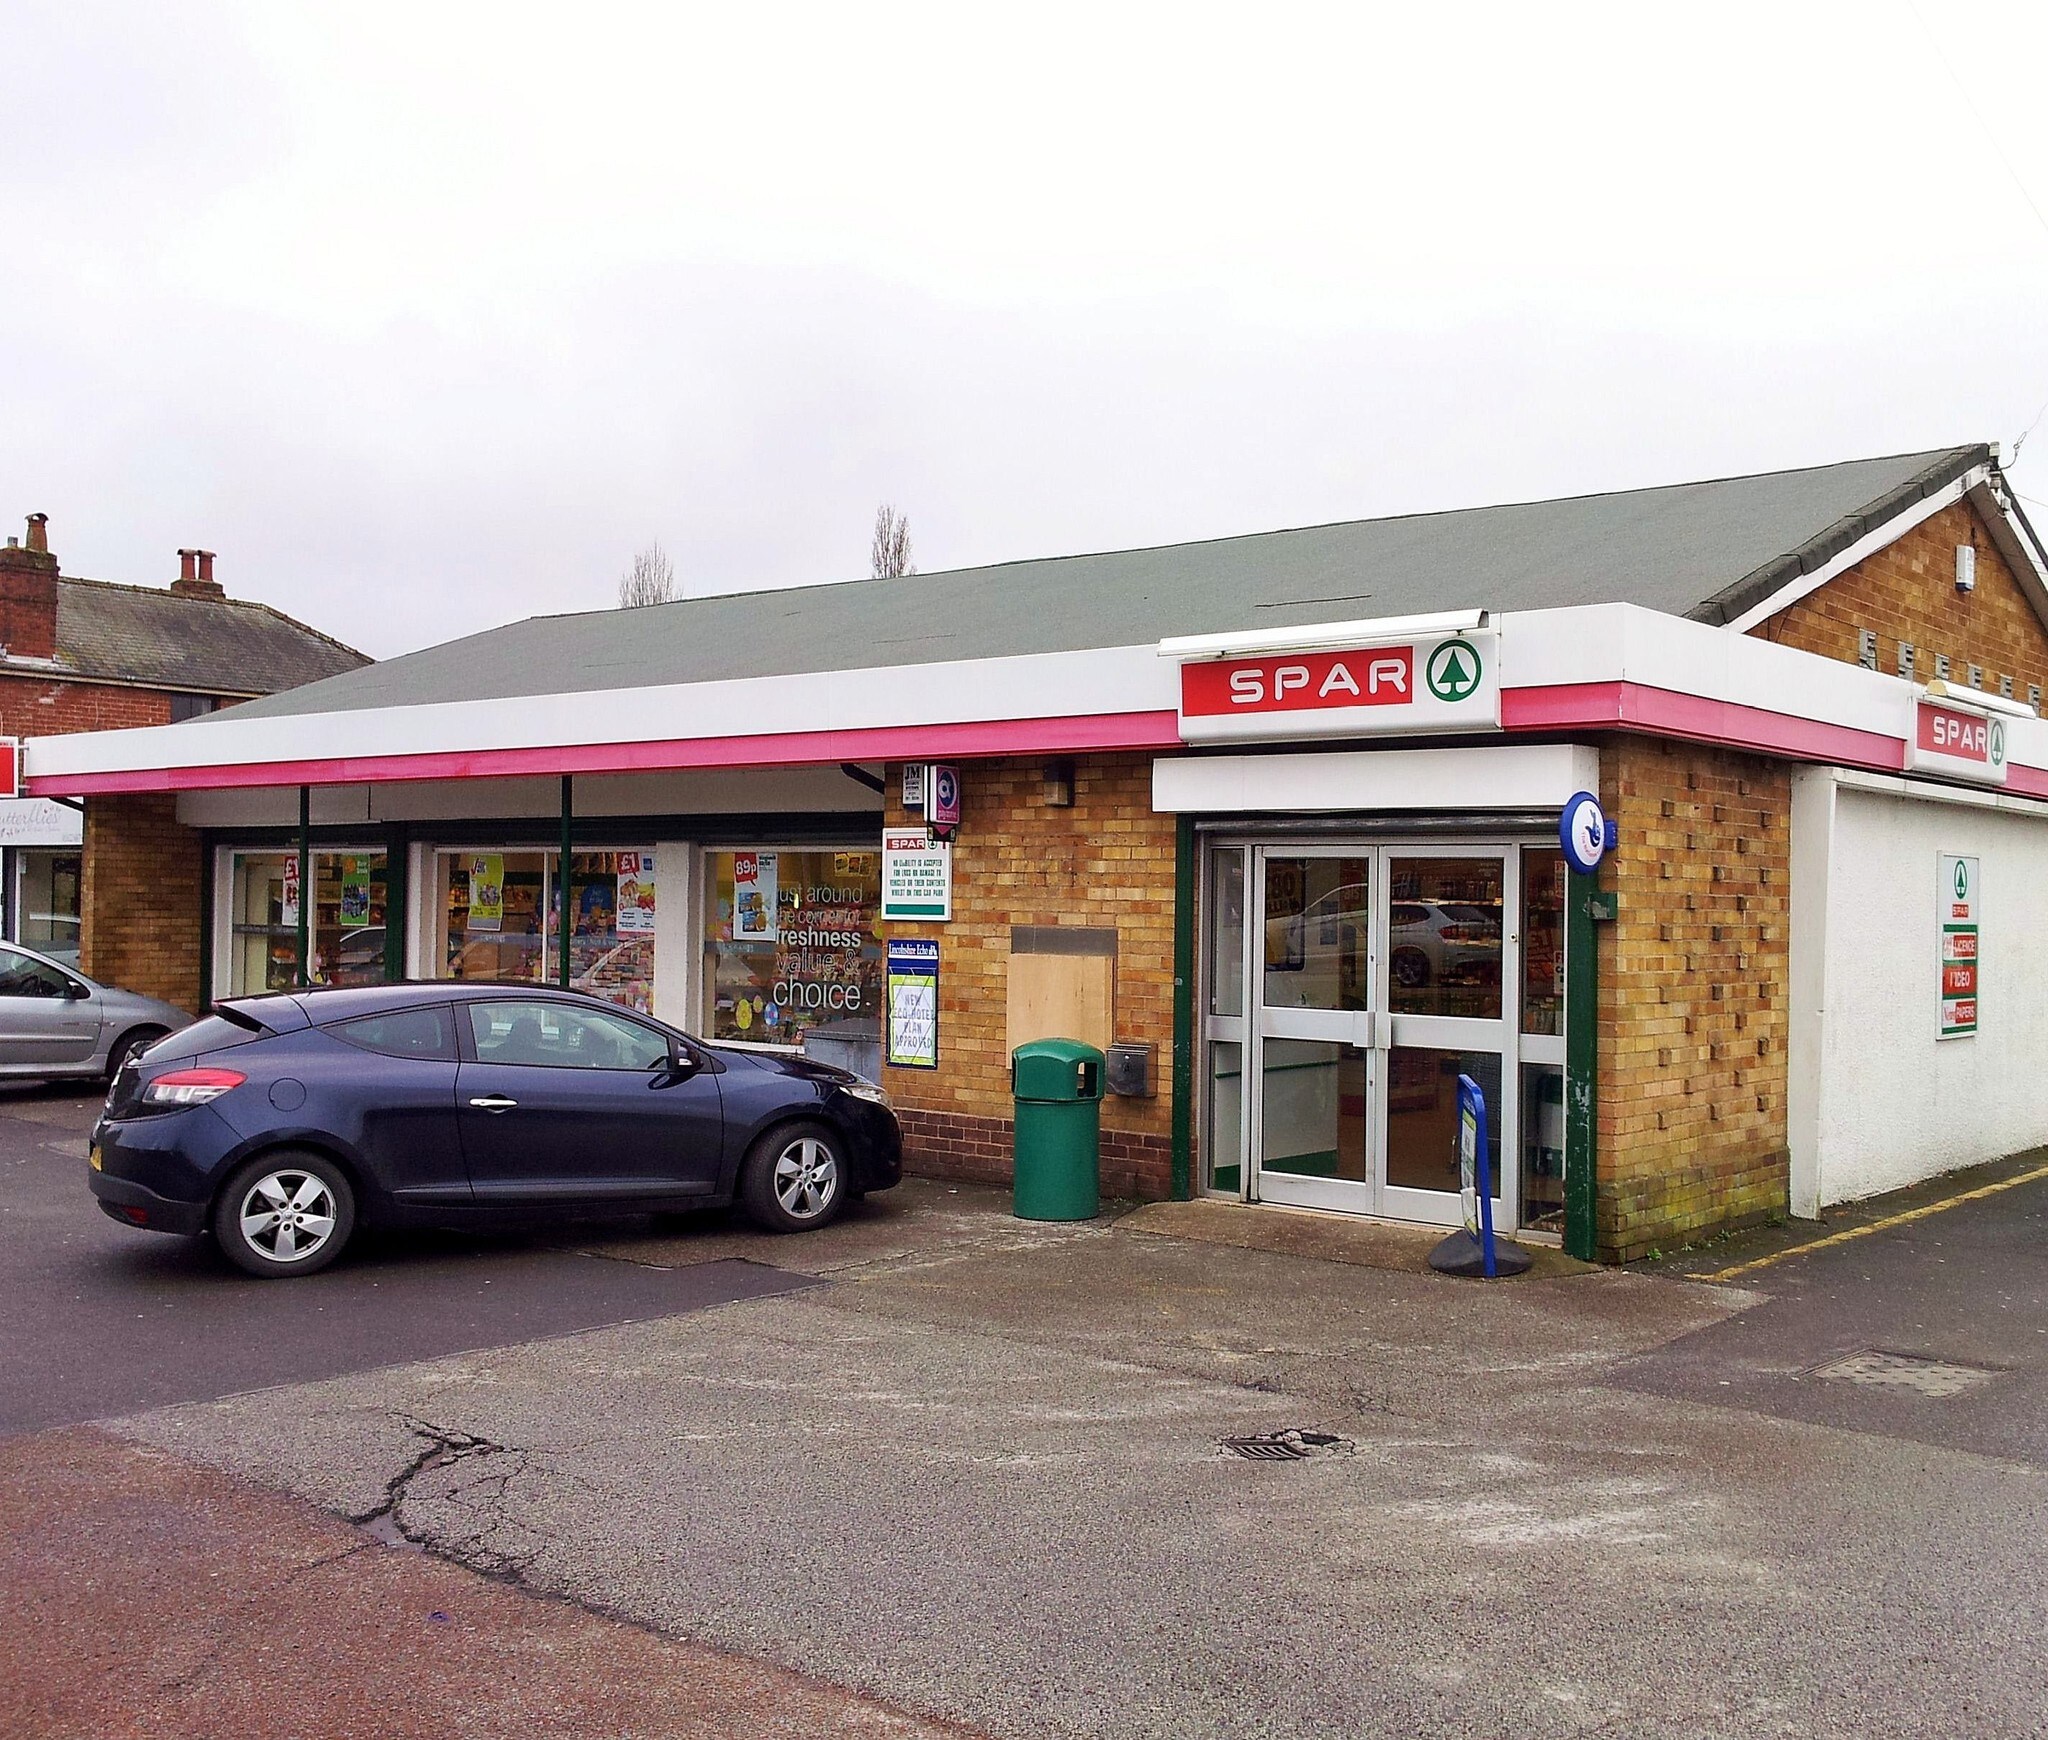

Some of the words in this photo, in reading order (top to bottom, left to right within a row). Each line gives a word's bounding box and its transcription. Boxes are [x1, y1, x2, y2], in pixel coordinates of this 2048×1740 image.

[1229, 658, 1408, 704] SPAR
[1933, 715, 1986, 753] SPAR
[0, 802, 62, 825] utterflies
[891, 839, 925, 850] SPAR
[620, 853, 636, 870] £1
[735, 859, 758, 876] 89p
[779, 883, 803, 903] ust
[806, 882, 863, 904] around
[797, 909, 843, 925] corner
[1953, 905, 1968, 917] SPAR
[889, 943, 916, 955] Lincolnshire
[916, 944, 928, 955] Echo
[775, 948, 837, 974] value
[843, 948, 861, 975] &
[1949, 971, 1970, 988] VIDEO
[773, 977, 862, 1011] choice
